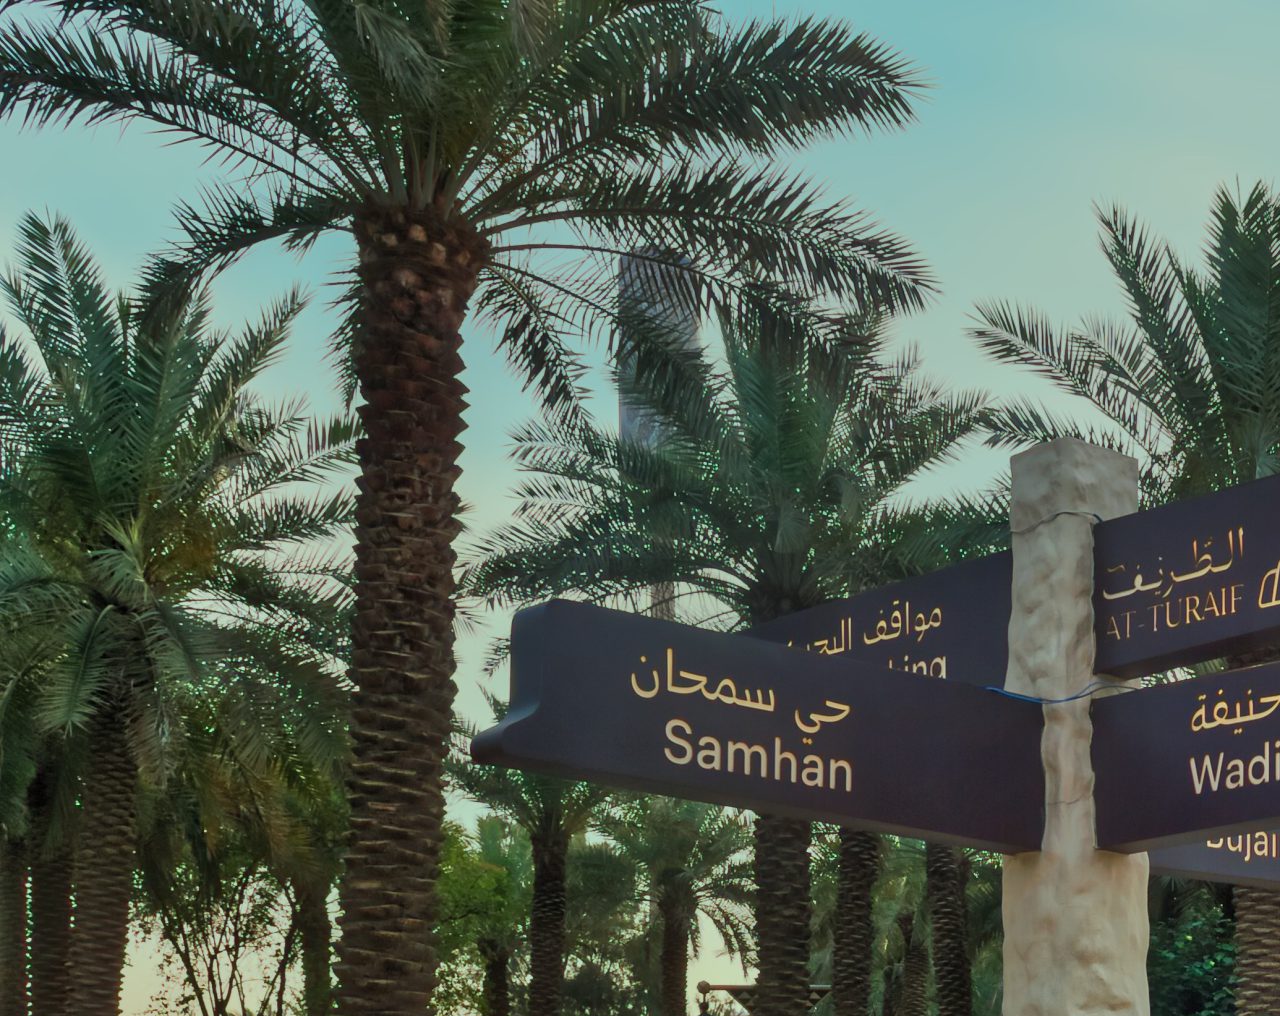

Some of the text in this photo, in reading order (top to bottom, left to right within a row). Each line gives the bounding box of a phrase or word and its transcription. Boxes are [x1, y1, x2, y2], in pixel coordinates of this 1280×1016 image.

[863, 599, 942, 645] مواقف
[1106, 584, 1244, 640] AT-TURAIF
[631, 648, 851, 744] حي سمحان
[664, 718, 853, 792] Samhan
[1189, 740, 1280, 794] Wadi
